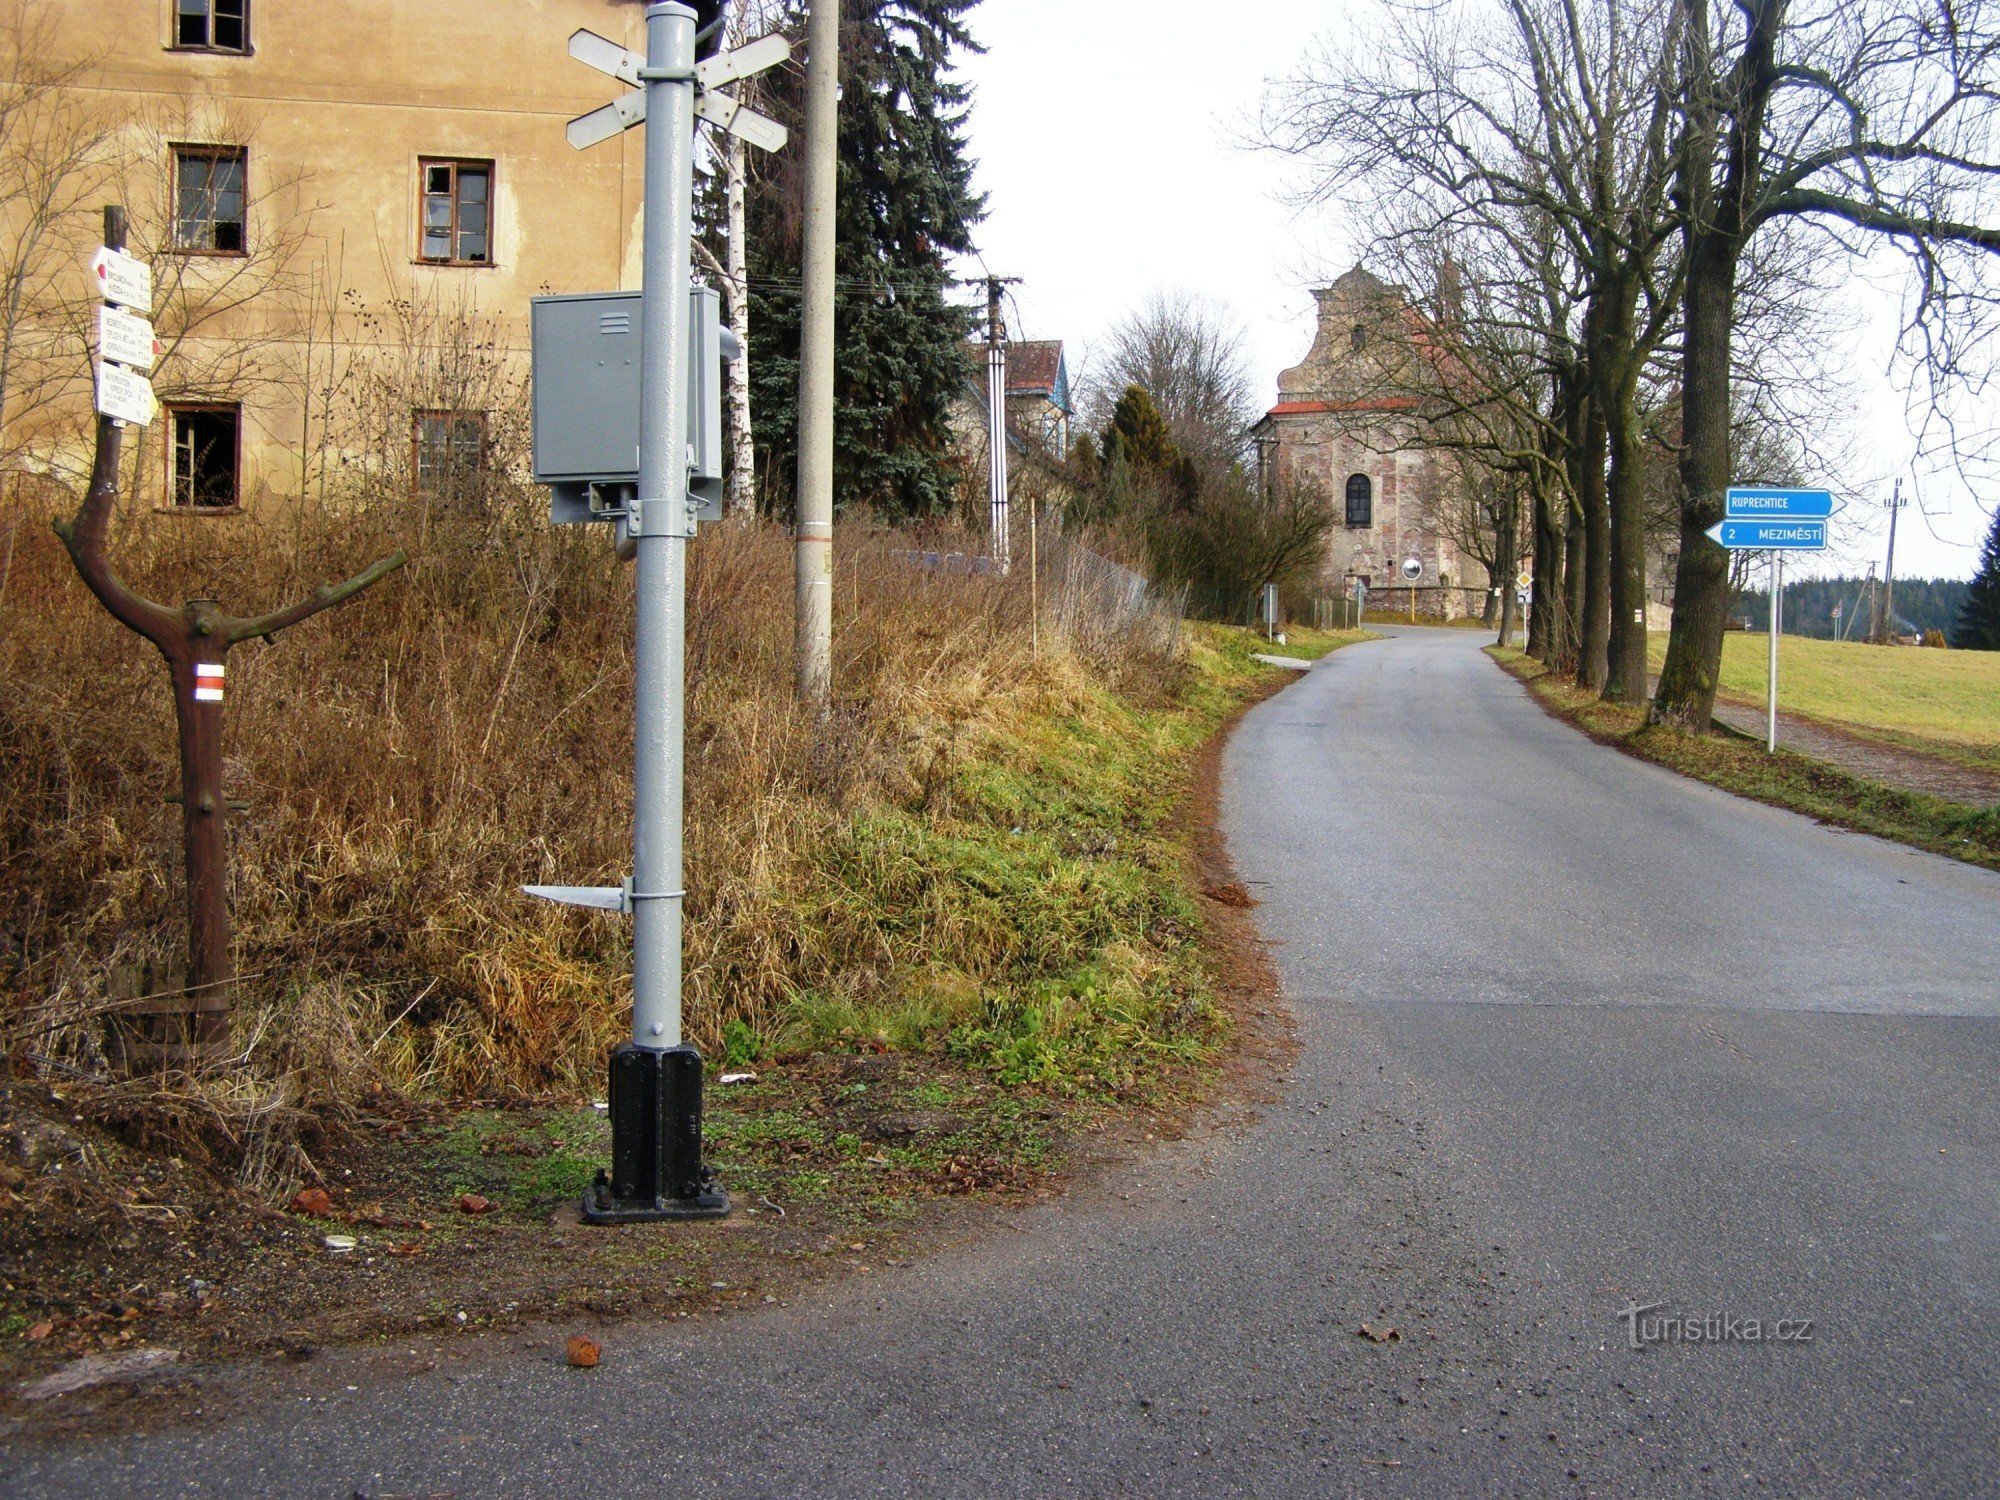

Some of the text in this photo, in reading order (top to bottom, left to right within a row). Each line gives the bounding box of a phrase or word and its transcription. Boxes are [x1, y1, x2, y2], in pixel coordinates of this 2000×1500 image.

[1731, 497, 1788, 508] RUPRECHTICE
[1728, 526, 1823, 540] 2 MEZIMĚSTÍ
